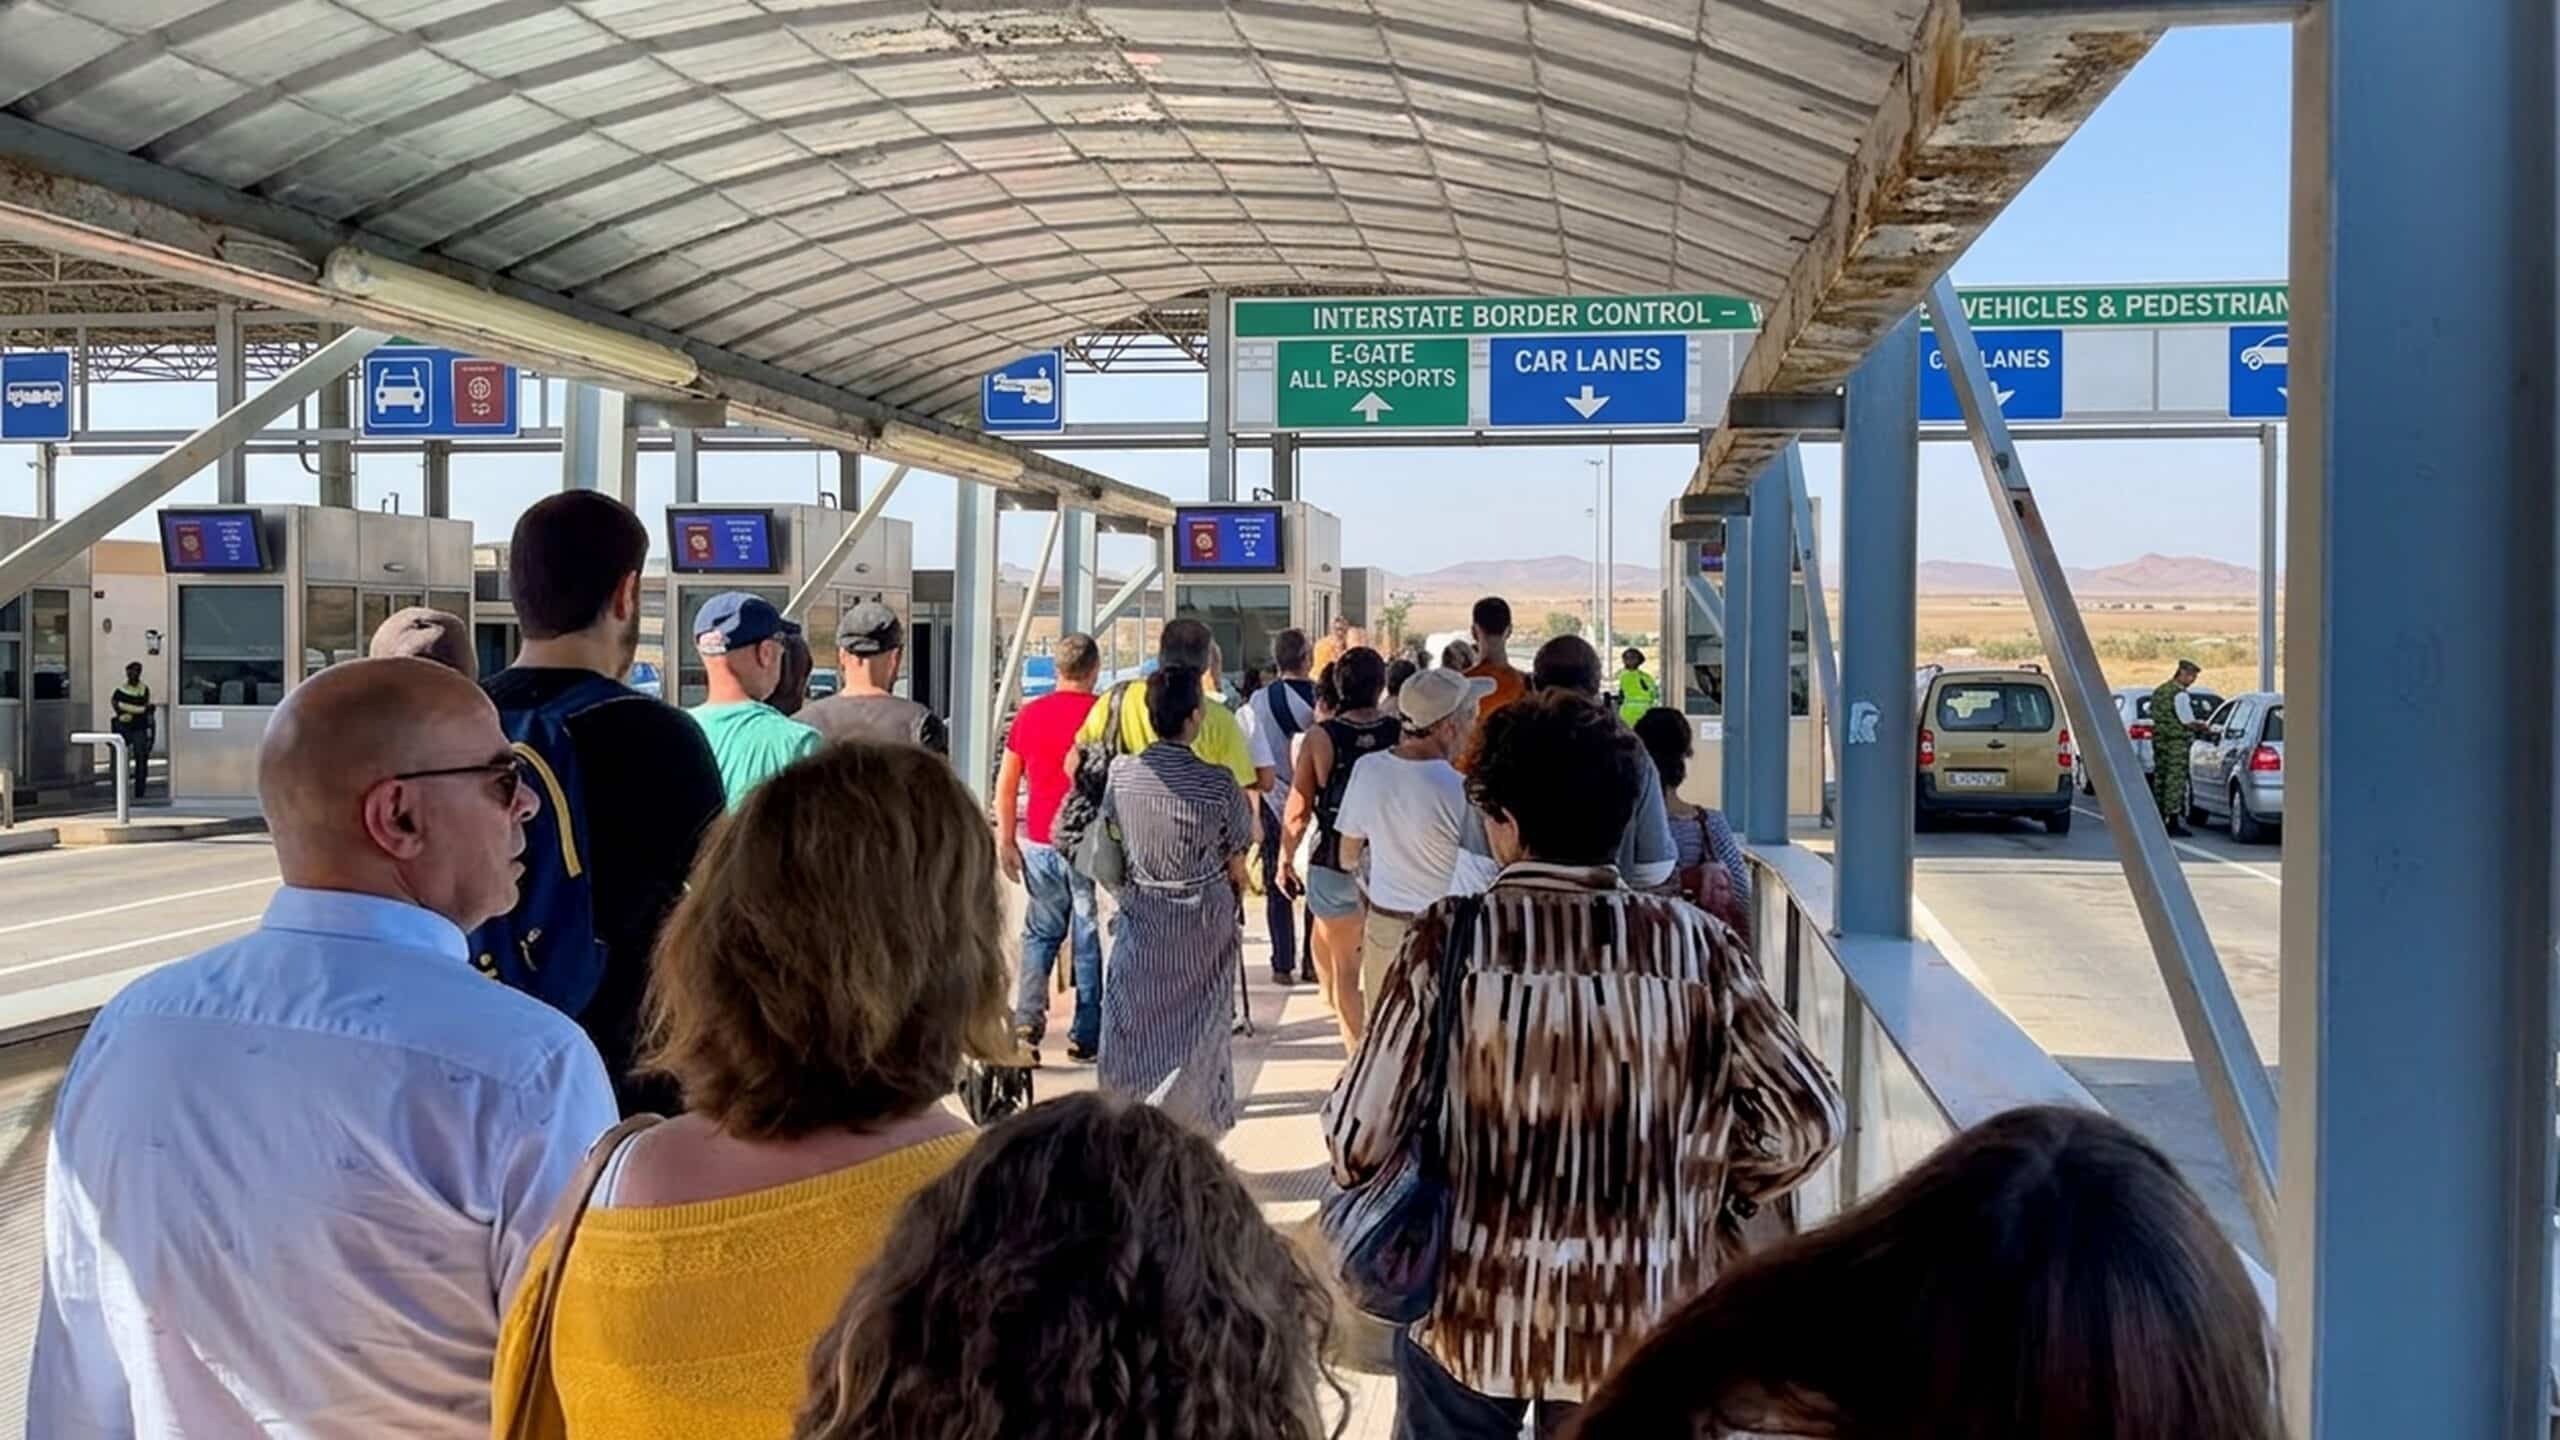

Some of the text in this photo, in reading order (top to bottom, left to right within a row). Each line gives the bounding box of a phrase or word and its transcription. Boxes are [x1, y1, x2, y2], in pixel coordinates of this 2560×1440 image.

[1313, 305, 1464, 329] INTERSTATE
[1473, 303, 1578, 327] BORDER
[1587, 301, 1711, 325] CONTROL
[1961, 296, 2089, 320] VEHICLES
[2098, 295, 2117, 318] &
[1330, 343, 1415, 365] E-GATE
[1515, 347, 1662, 373] CAR LANES
[1980, 348, 2050, 370] LANES
[1289, 367, 1456, 389] ALL PASSPORTS
